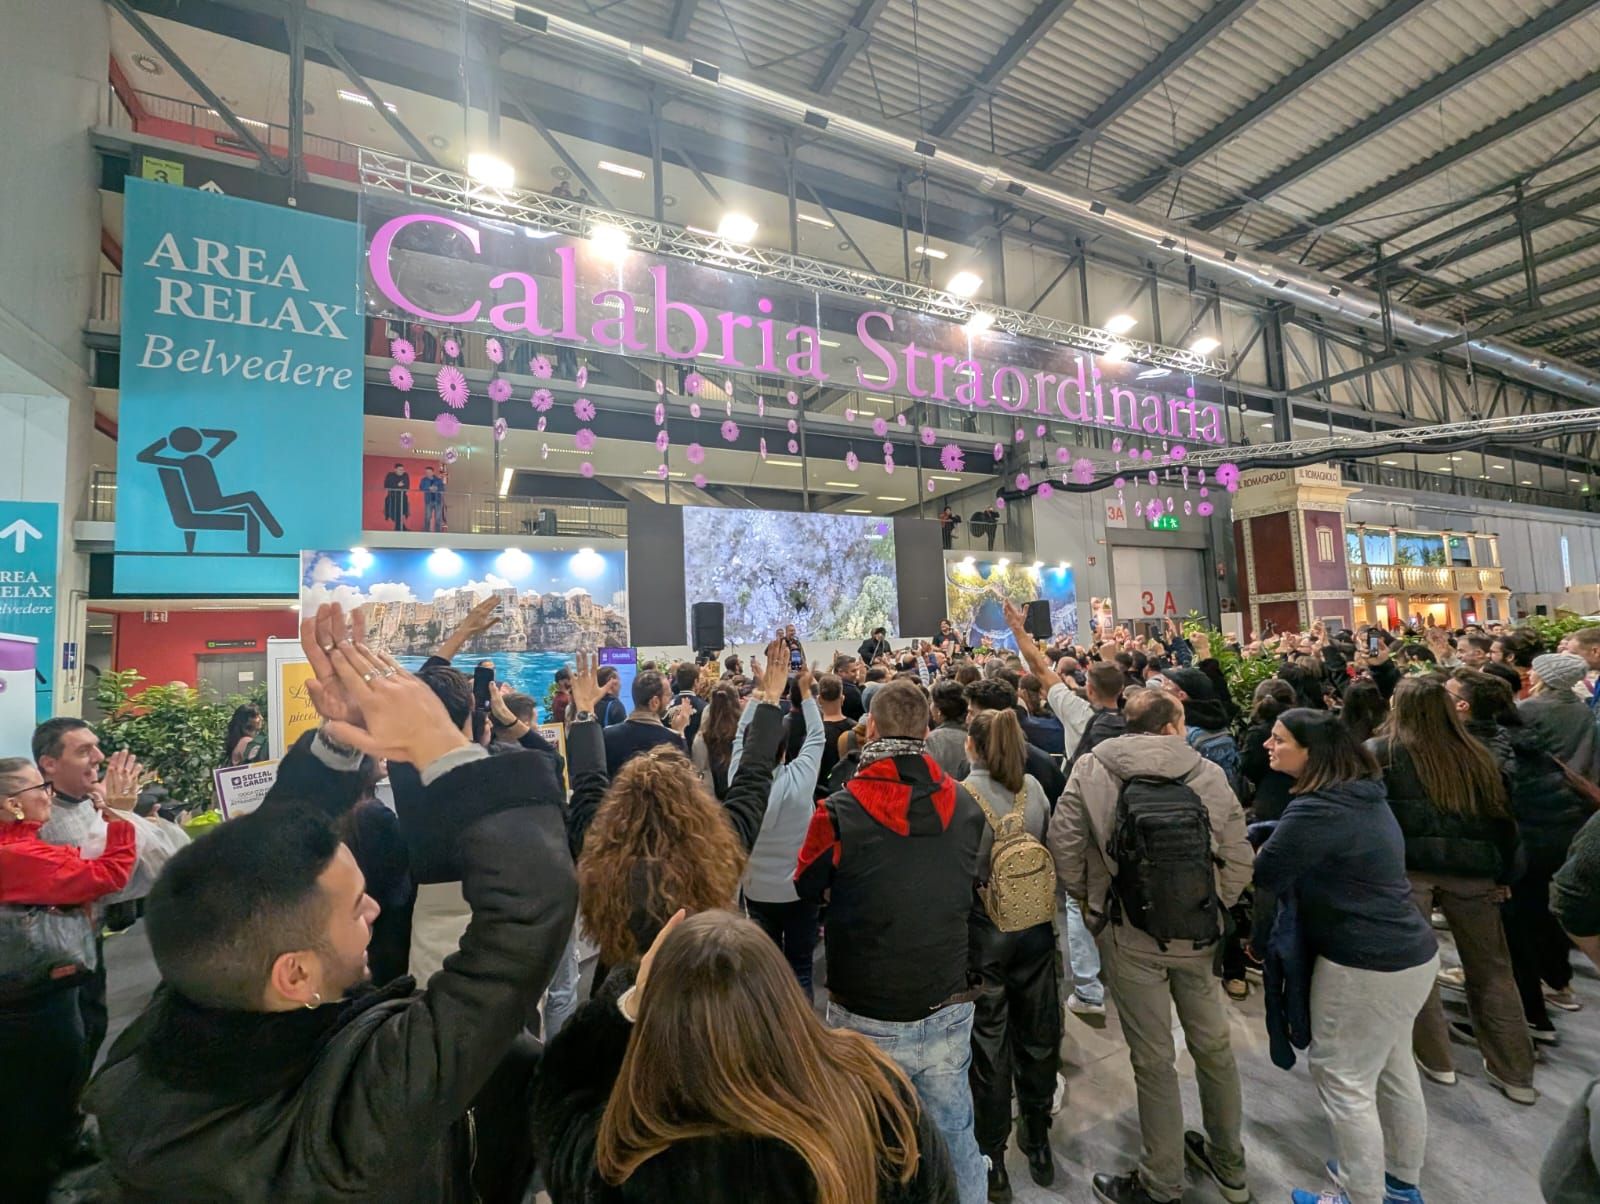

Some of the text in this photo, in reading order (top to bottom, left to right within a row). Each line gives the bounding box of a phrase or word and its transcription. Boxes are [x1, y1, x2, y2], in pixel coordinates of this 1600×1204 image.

[143, 232, 310, 292] AREA
[153, 276, 349, 340] RELAX
[368, 213, 1226, 444] Calabria Straordinaria
[137, 333, 353, 390] Belvedere
[1107, 506, 1125, 521] 3A
[0, 570, 39, 583] REA
[0, 586, 52, 598] ELAX
[1141, 591, 1177, 616] 3 A
[242, 770, 272, 782] SOCIAL
[243, 777, 273, 788] GARDEN
